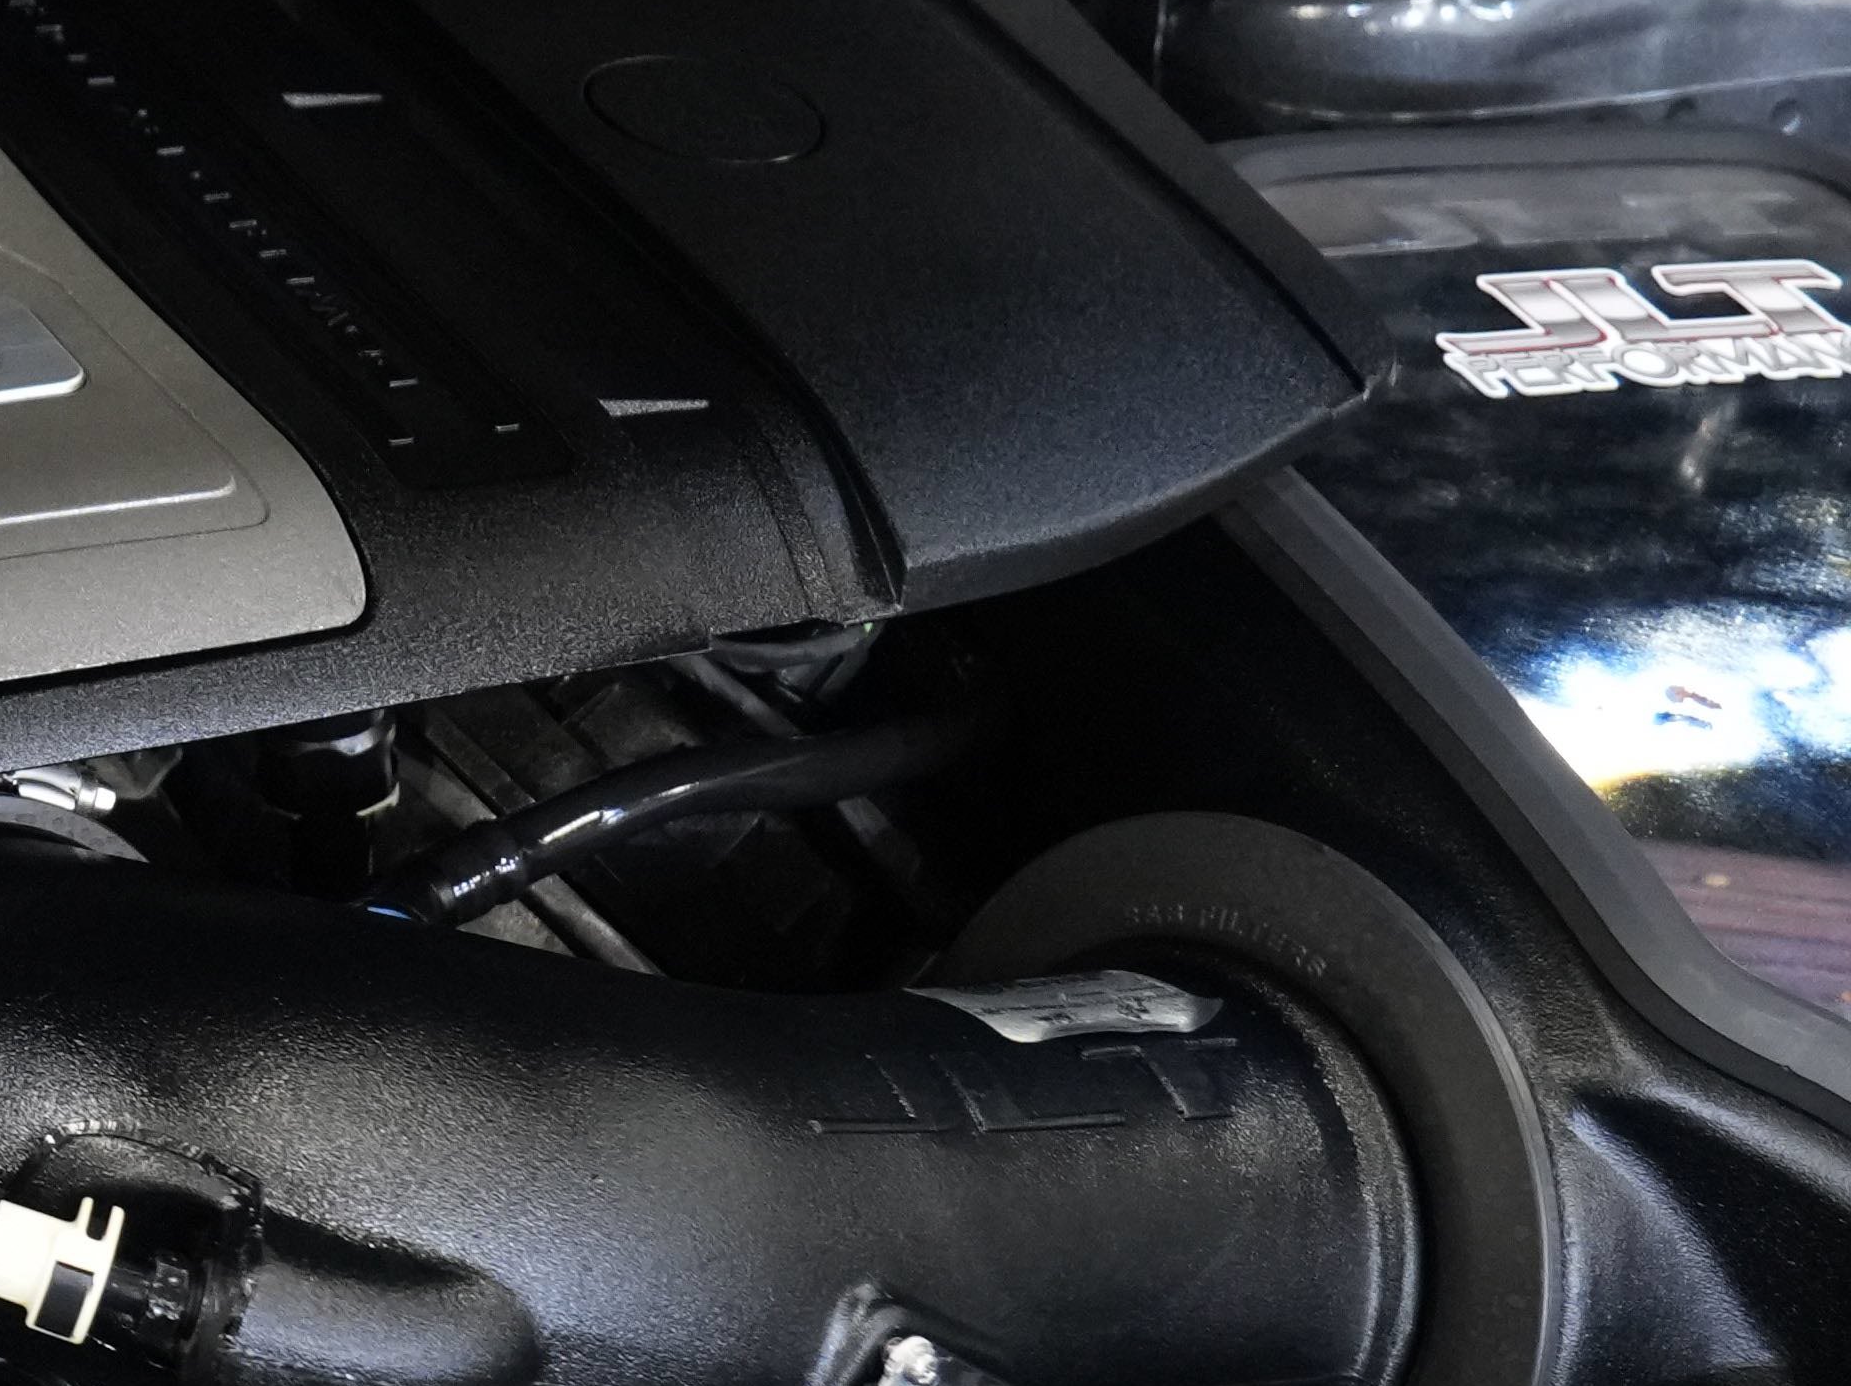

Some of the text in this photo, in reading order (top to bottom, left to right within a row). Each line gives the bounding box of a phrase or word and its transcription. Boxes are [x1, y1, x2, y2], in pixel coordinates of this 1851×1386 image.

[1436, 259, 1848, 355] JLT
[1443, 329, 1851, 399] PERFORMAN
[807, 1036, 1238, 1135] JLT
